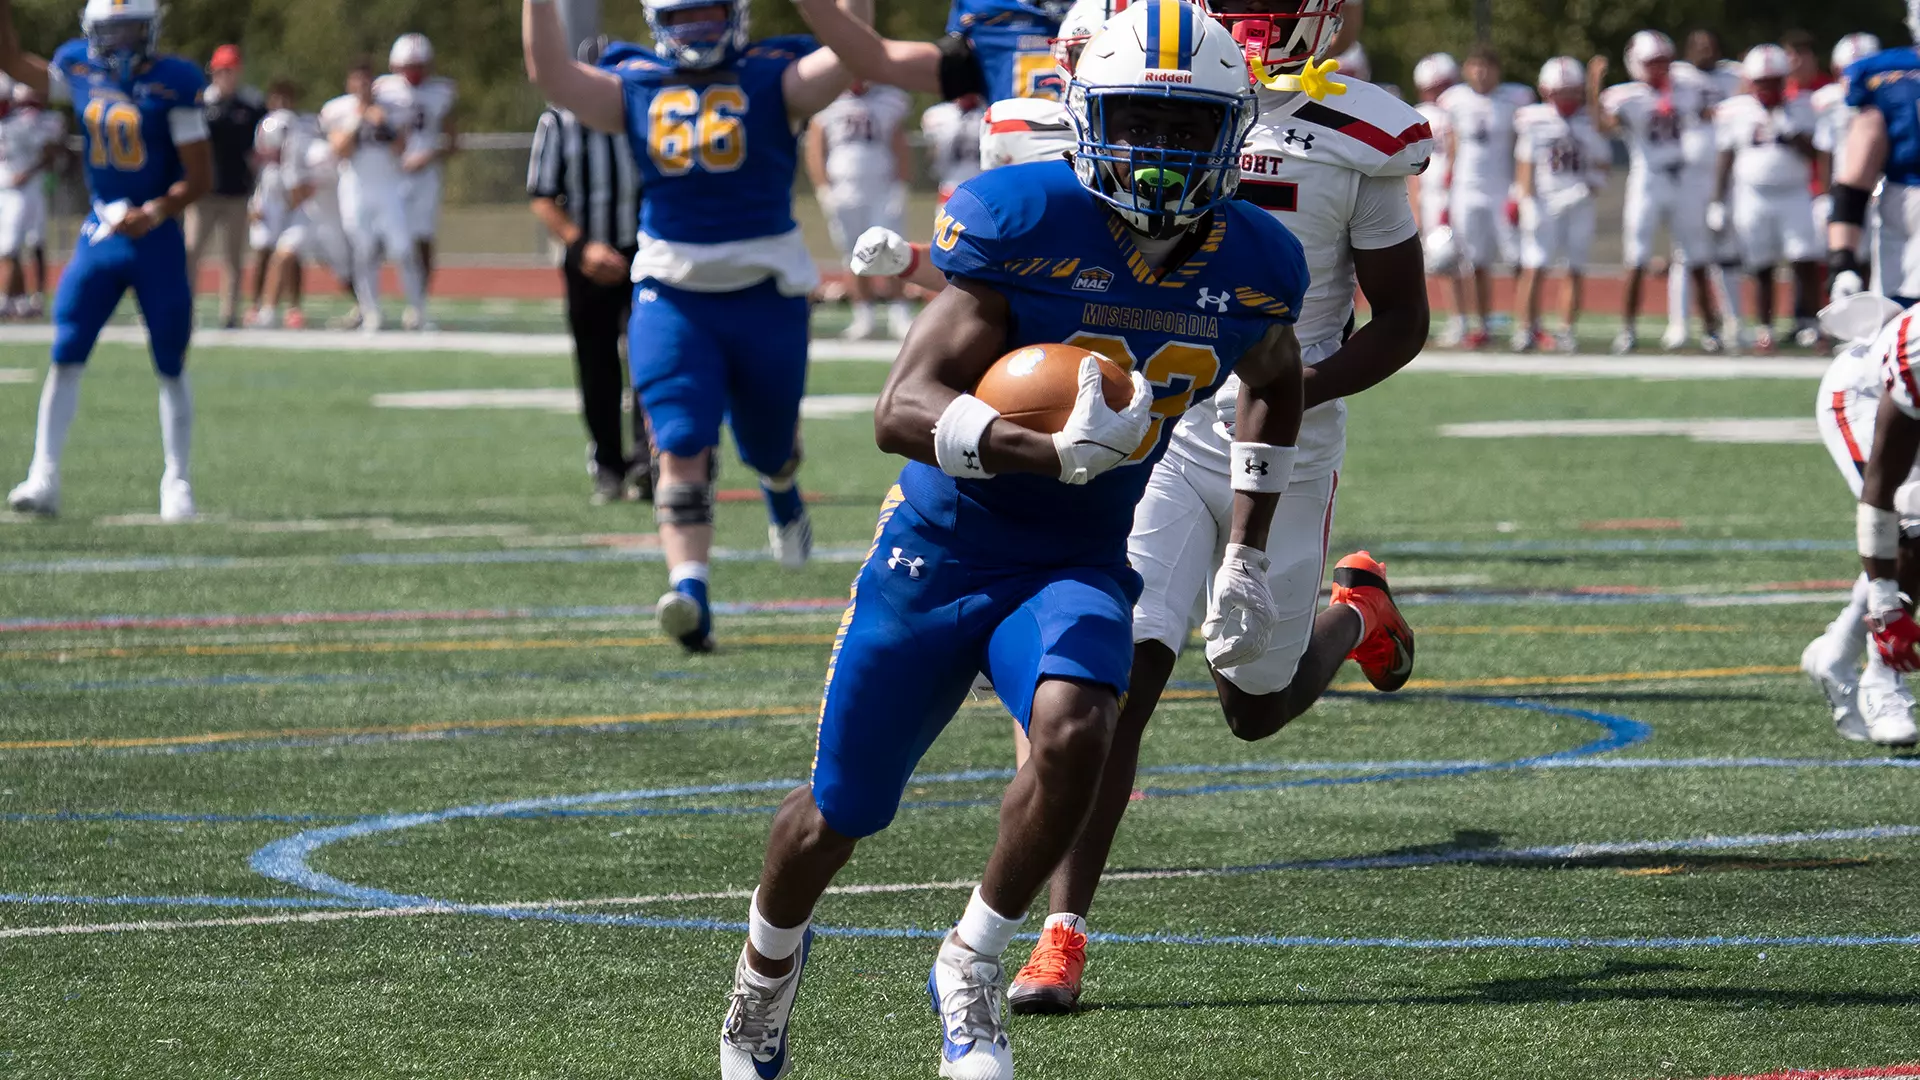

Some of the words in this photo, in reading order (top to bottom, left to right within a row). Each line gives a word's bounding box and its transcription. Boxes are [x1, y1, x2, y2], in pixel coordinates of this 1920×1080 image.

[1145, 72, 1192, 84] Riddell
[84, 98, 148, 172] 10
[647, 85, 749, 176] 66
[1235, 152, 1284, 176] GHT
[1075, 277, 1108, 290] MAC
[1082, 303, 1219, 339] MISERICORDIA
